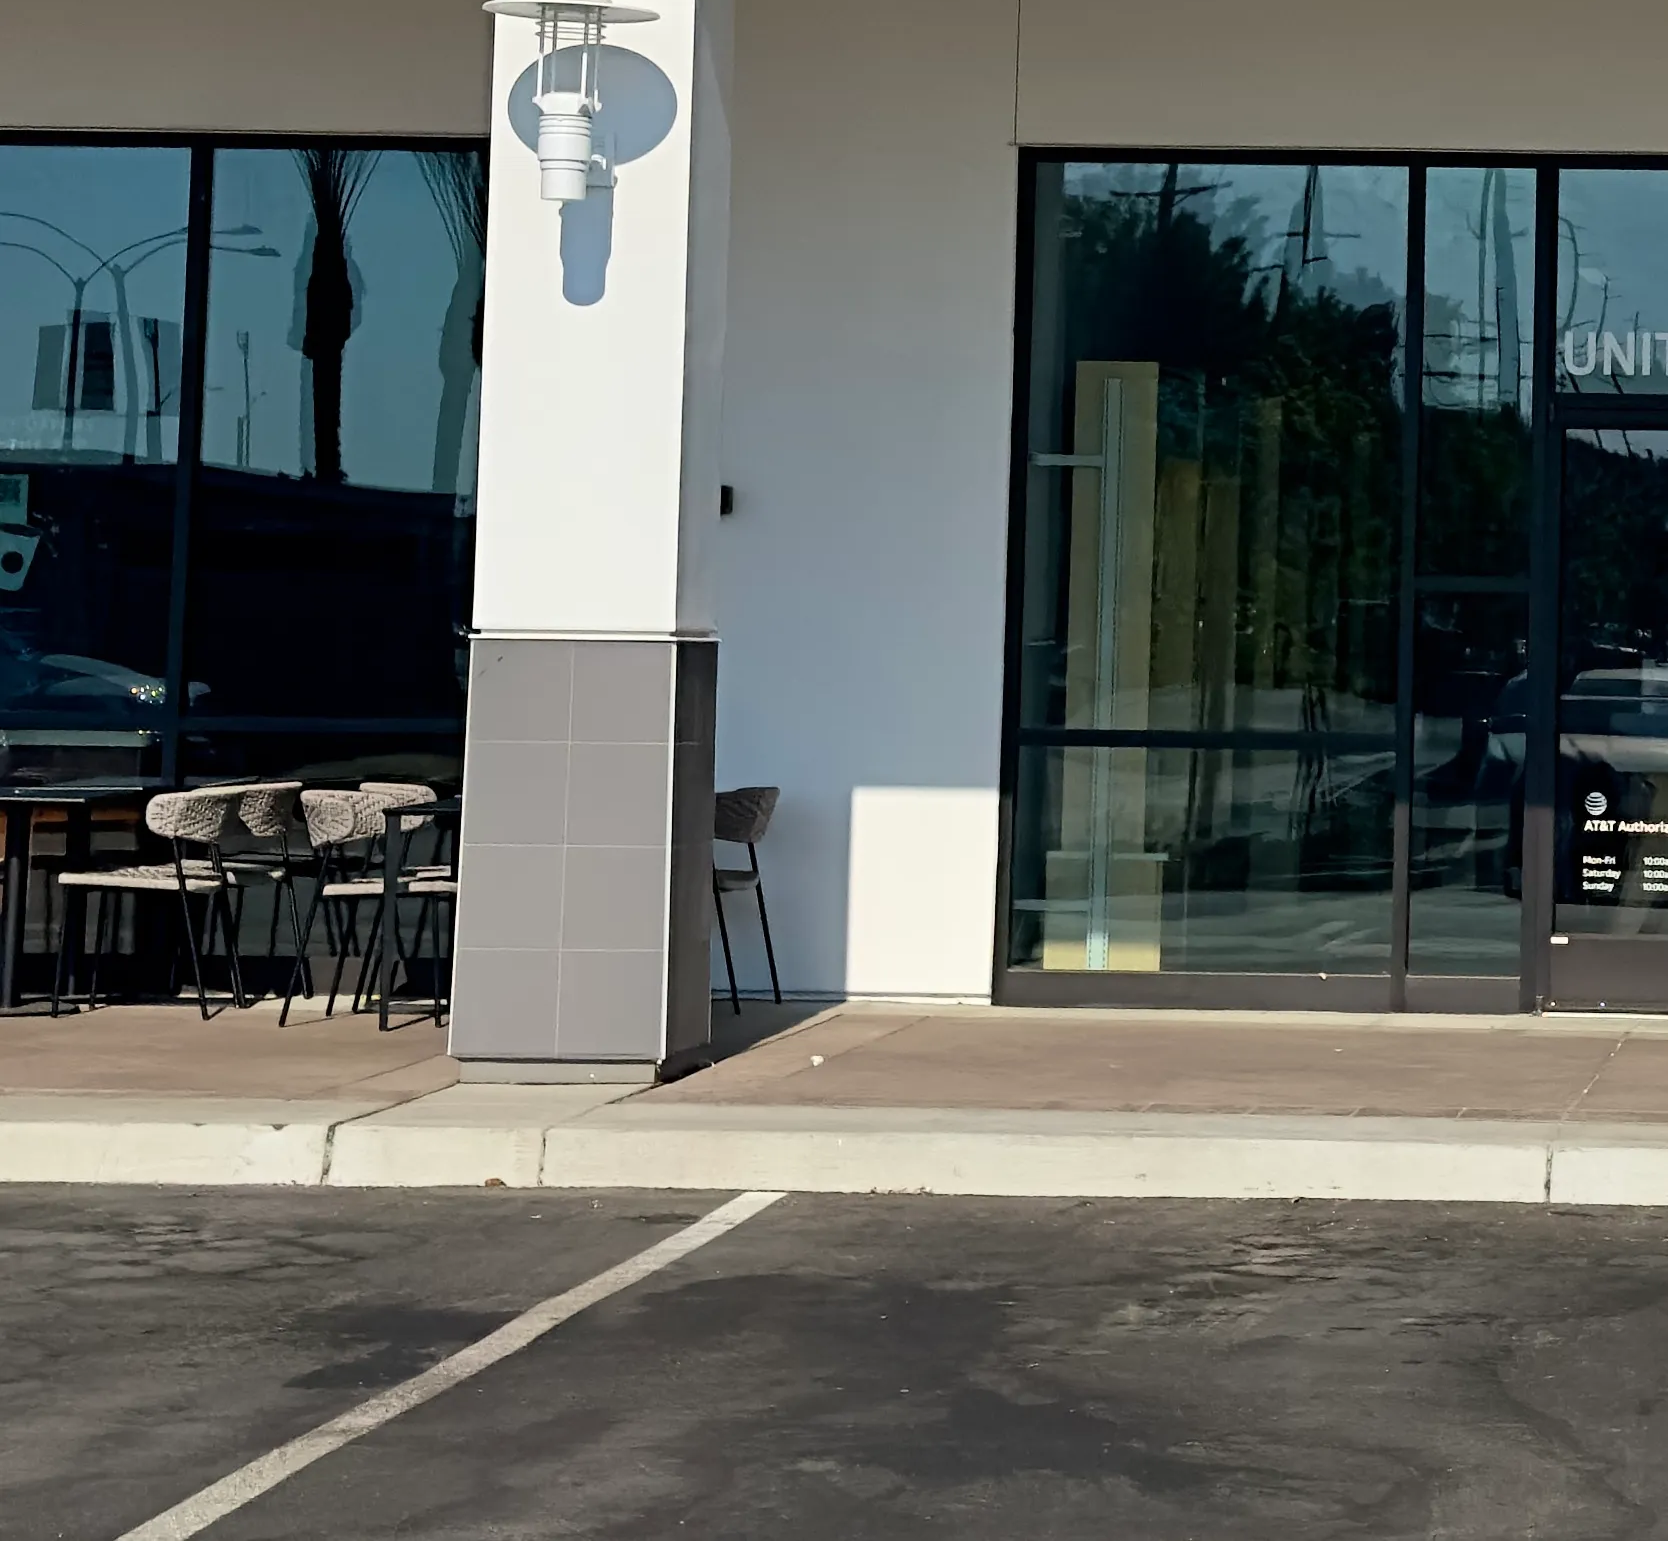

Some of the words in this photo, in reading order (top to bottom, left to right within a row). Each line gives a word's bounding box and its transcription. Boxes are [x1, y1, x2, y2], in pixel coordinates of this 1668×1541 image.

[1584, 819, 1617, 833] AT&T
[1582, 868, 1621, 880] Saturday
[1582, 881, 1614, 893] Sunday
